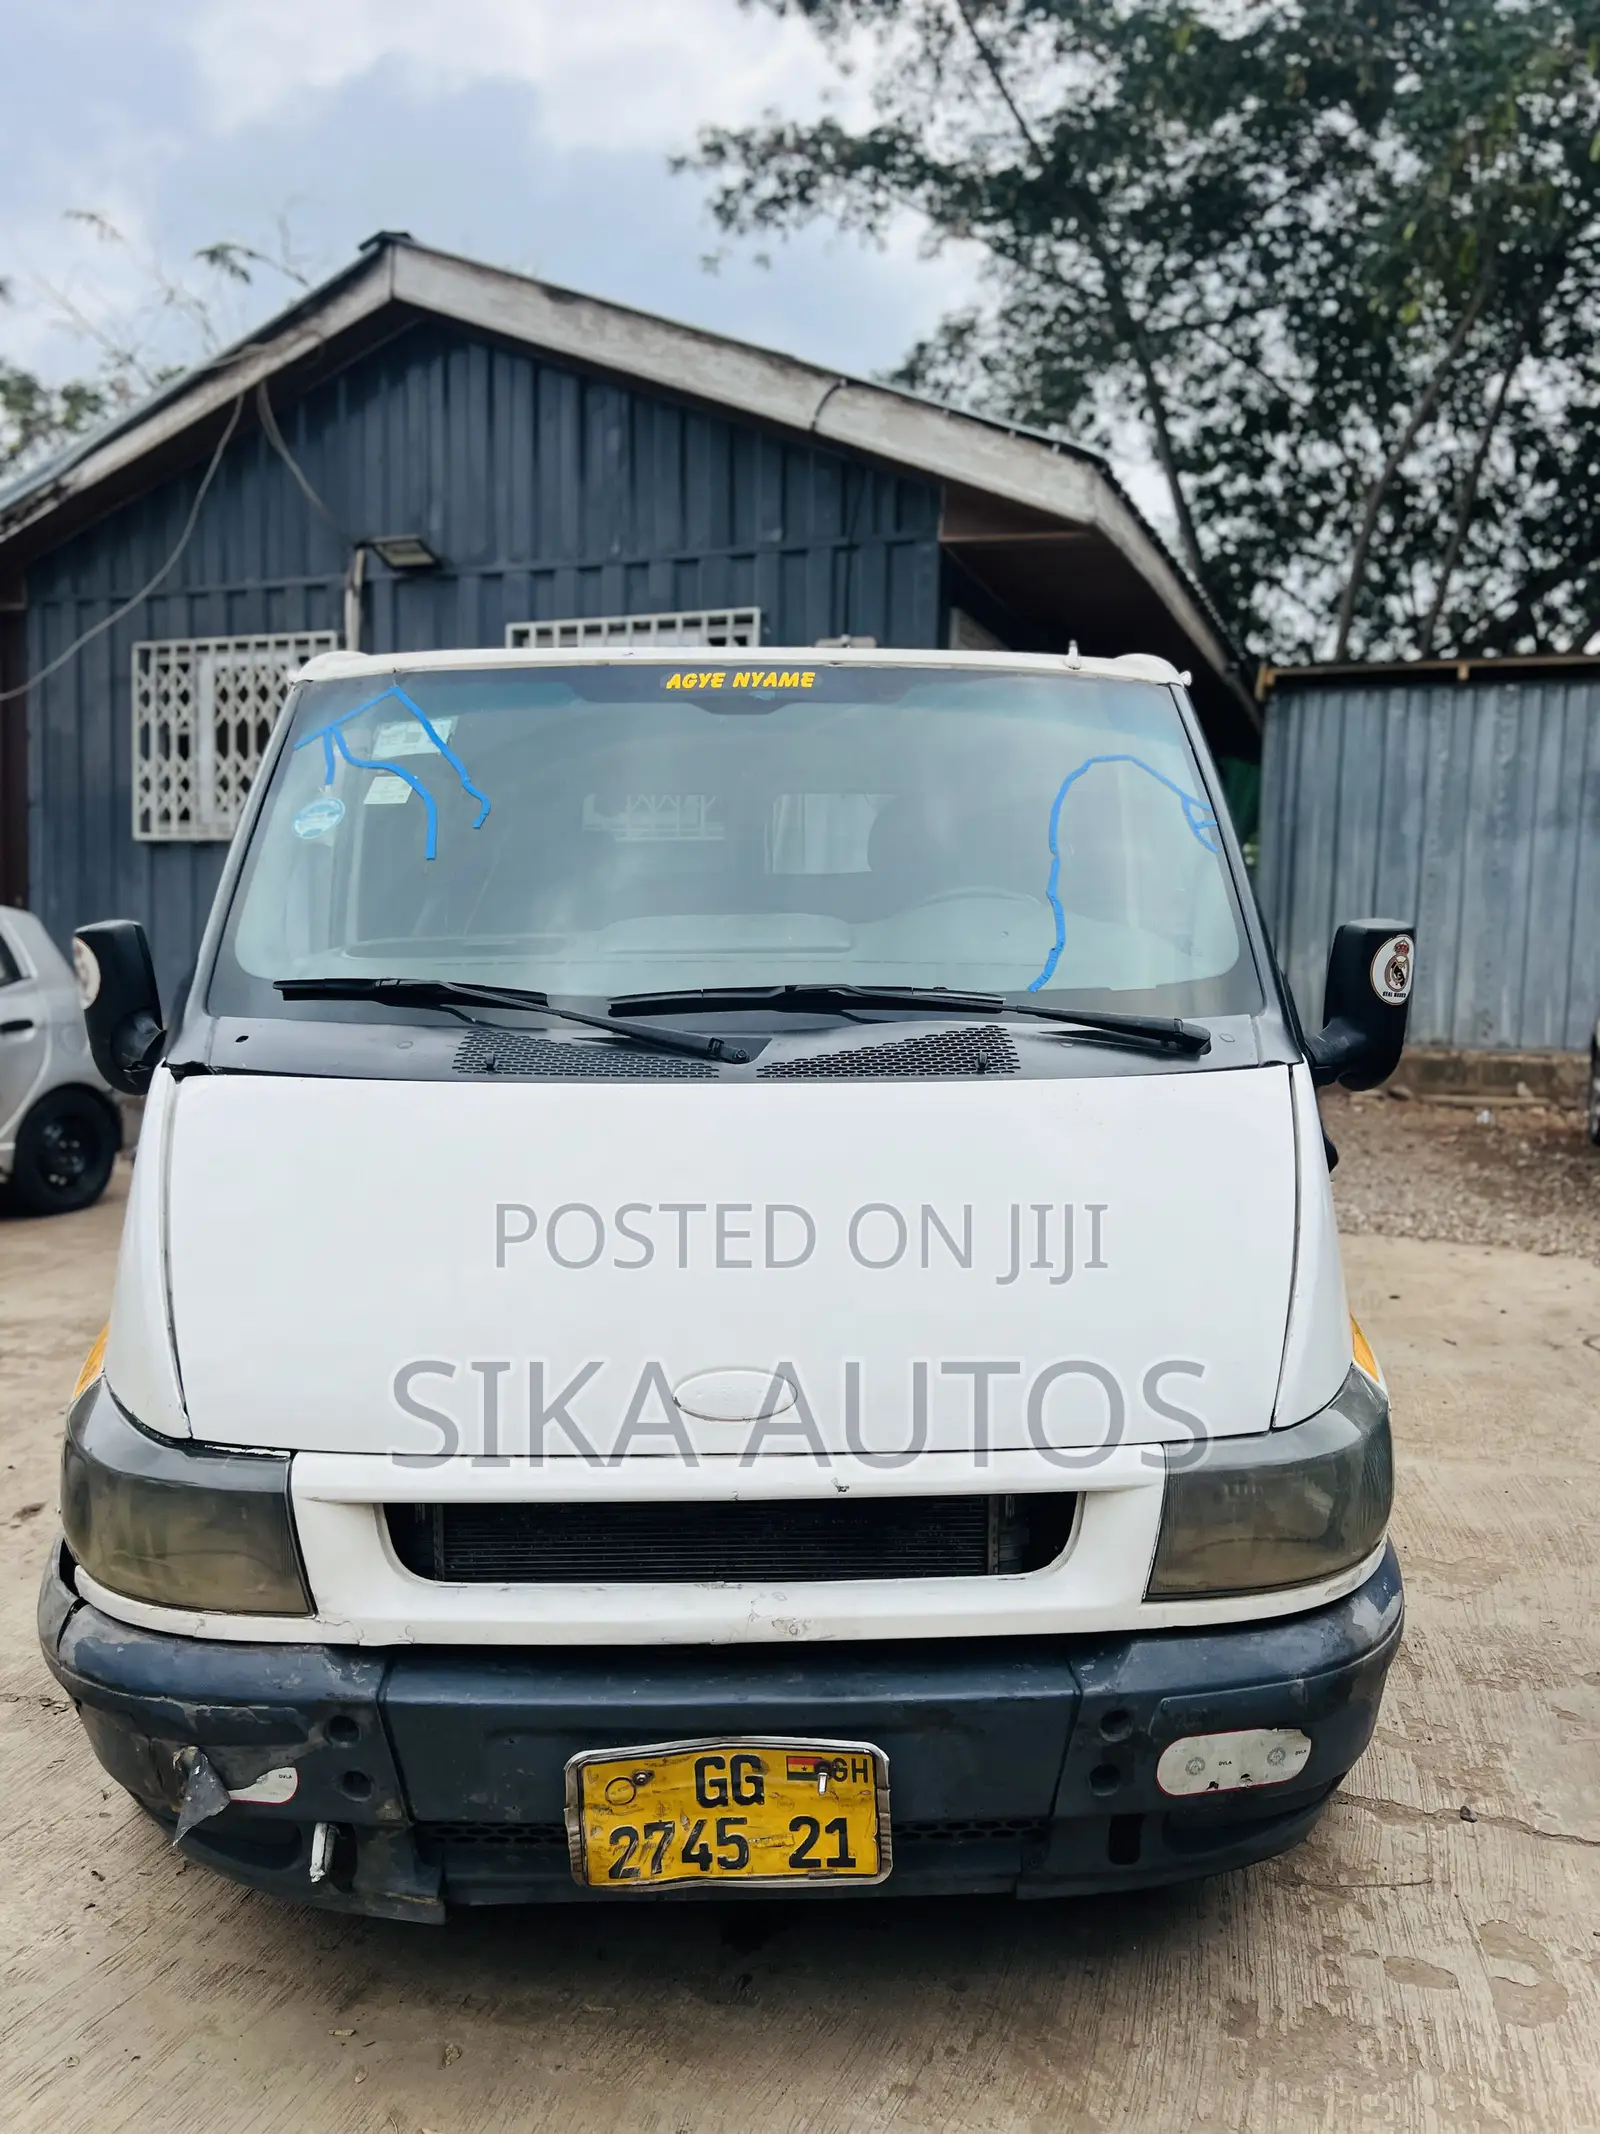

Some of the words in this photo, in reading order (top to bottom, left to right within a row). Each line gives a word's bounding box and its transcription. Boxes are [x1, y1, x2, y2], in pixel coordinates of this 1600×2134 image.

[665, 672, 727, 689] AGYE
[732, 672, 816, 688] NYAME
[694, 1754, 765, 1808] GG
[832, 1757, 869, 1783] GH
[608, 1816, 749, 1880] 2745
[788, 1815, 857, 1869] 21
